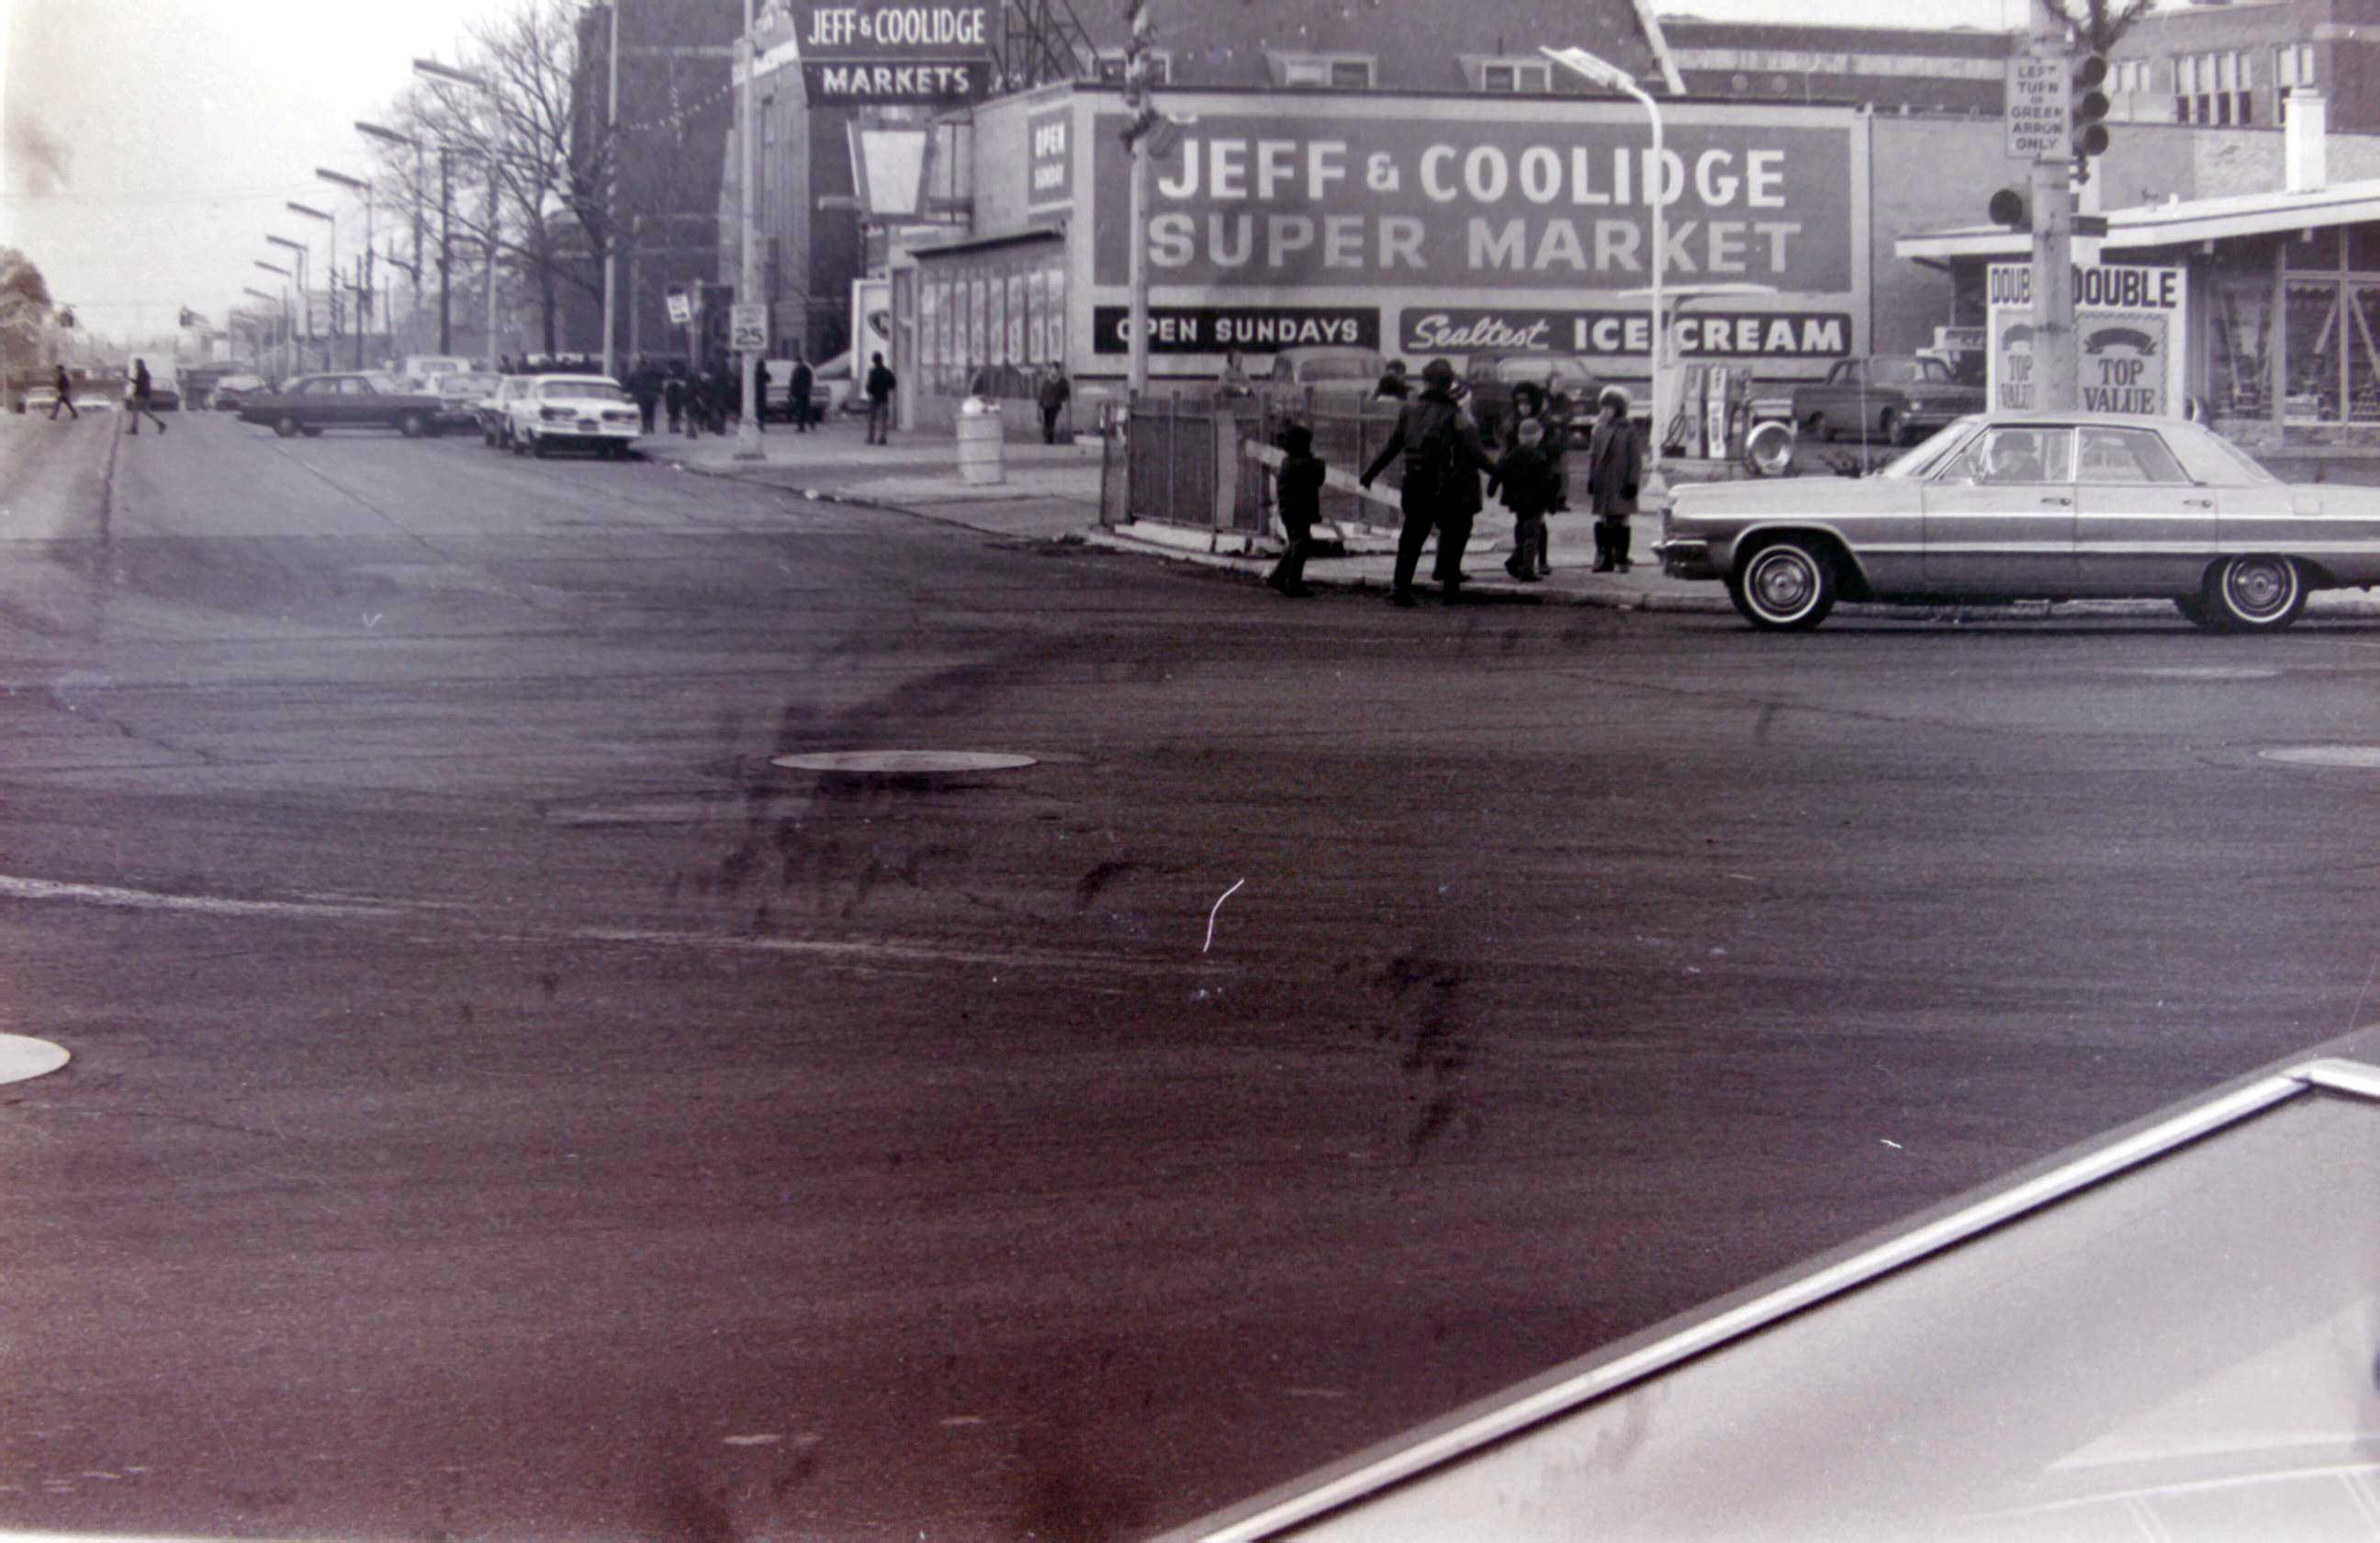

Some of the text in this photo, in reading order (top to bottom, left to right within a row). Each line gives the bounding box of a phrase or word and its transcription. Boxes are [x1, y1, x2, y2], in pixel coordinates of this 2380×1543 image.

[808, 7, 985, 44] JEFF & COOLIDGE
[823, 66, 970, 94] MARKETS
[2018, 65, 2057, 78] LEFT
[2017, 80, 2059, 94] TURN
[2011, 106, 2064, 118] GREEN
[2013, 122, 2062, 134] ARROW
[2015, 138, 2058, 150] ONLY
[1158, 139, 1785, 208] JEFF & COOLIDGE
[1148, 211, 1802, 273] SUPER MARKET
[1992, 267, 2032, 305] DOUB
[2071, 265, 2177, 309] DOUBLE
[735, 327, 764, 345] 25
[1215, 318, 1359, 343] SUNDAYS
[1408, 313, 1843, 353] Sealtest ICE CREAM
[2098, 358, 2144, 386] TOP
[2083, 387, 2155, 414] VALUE
